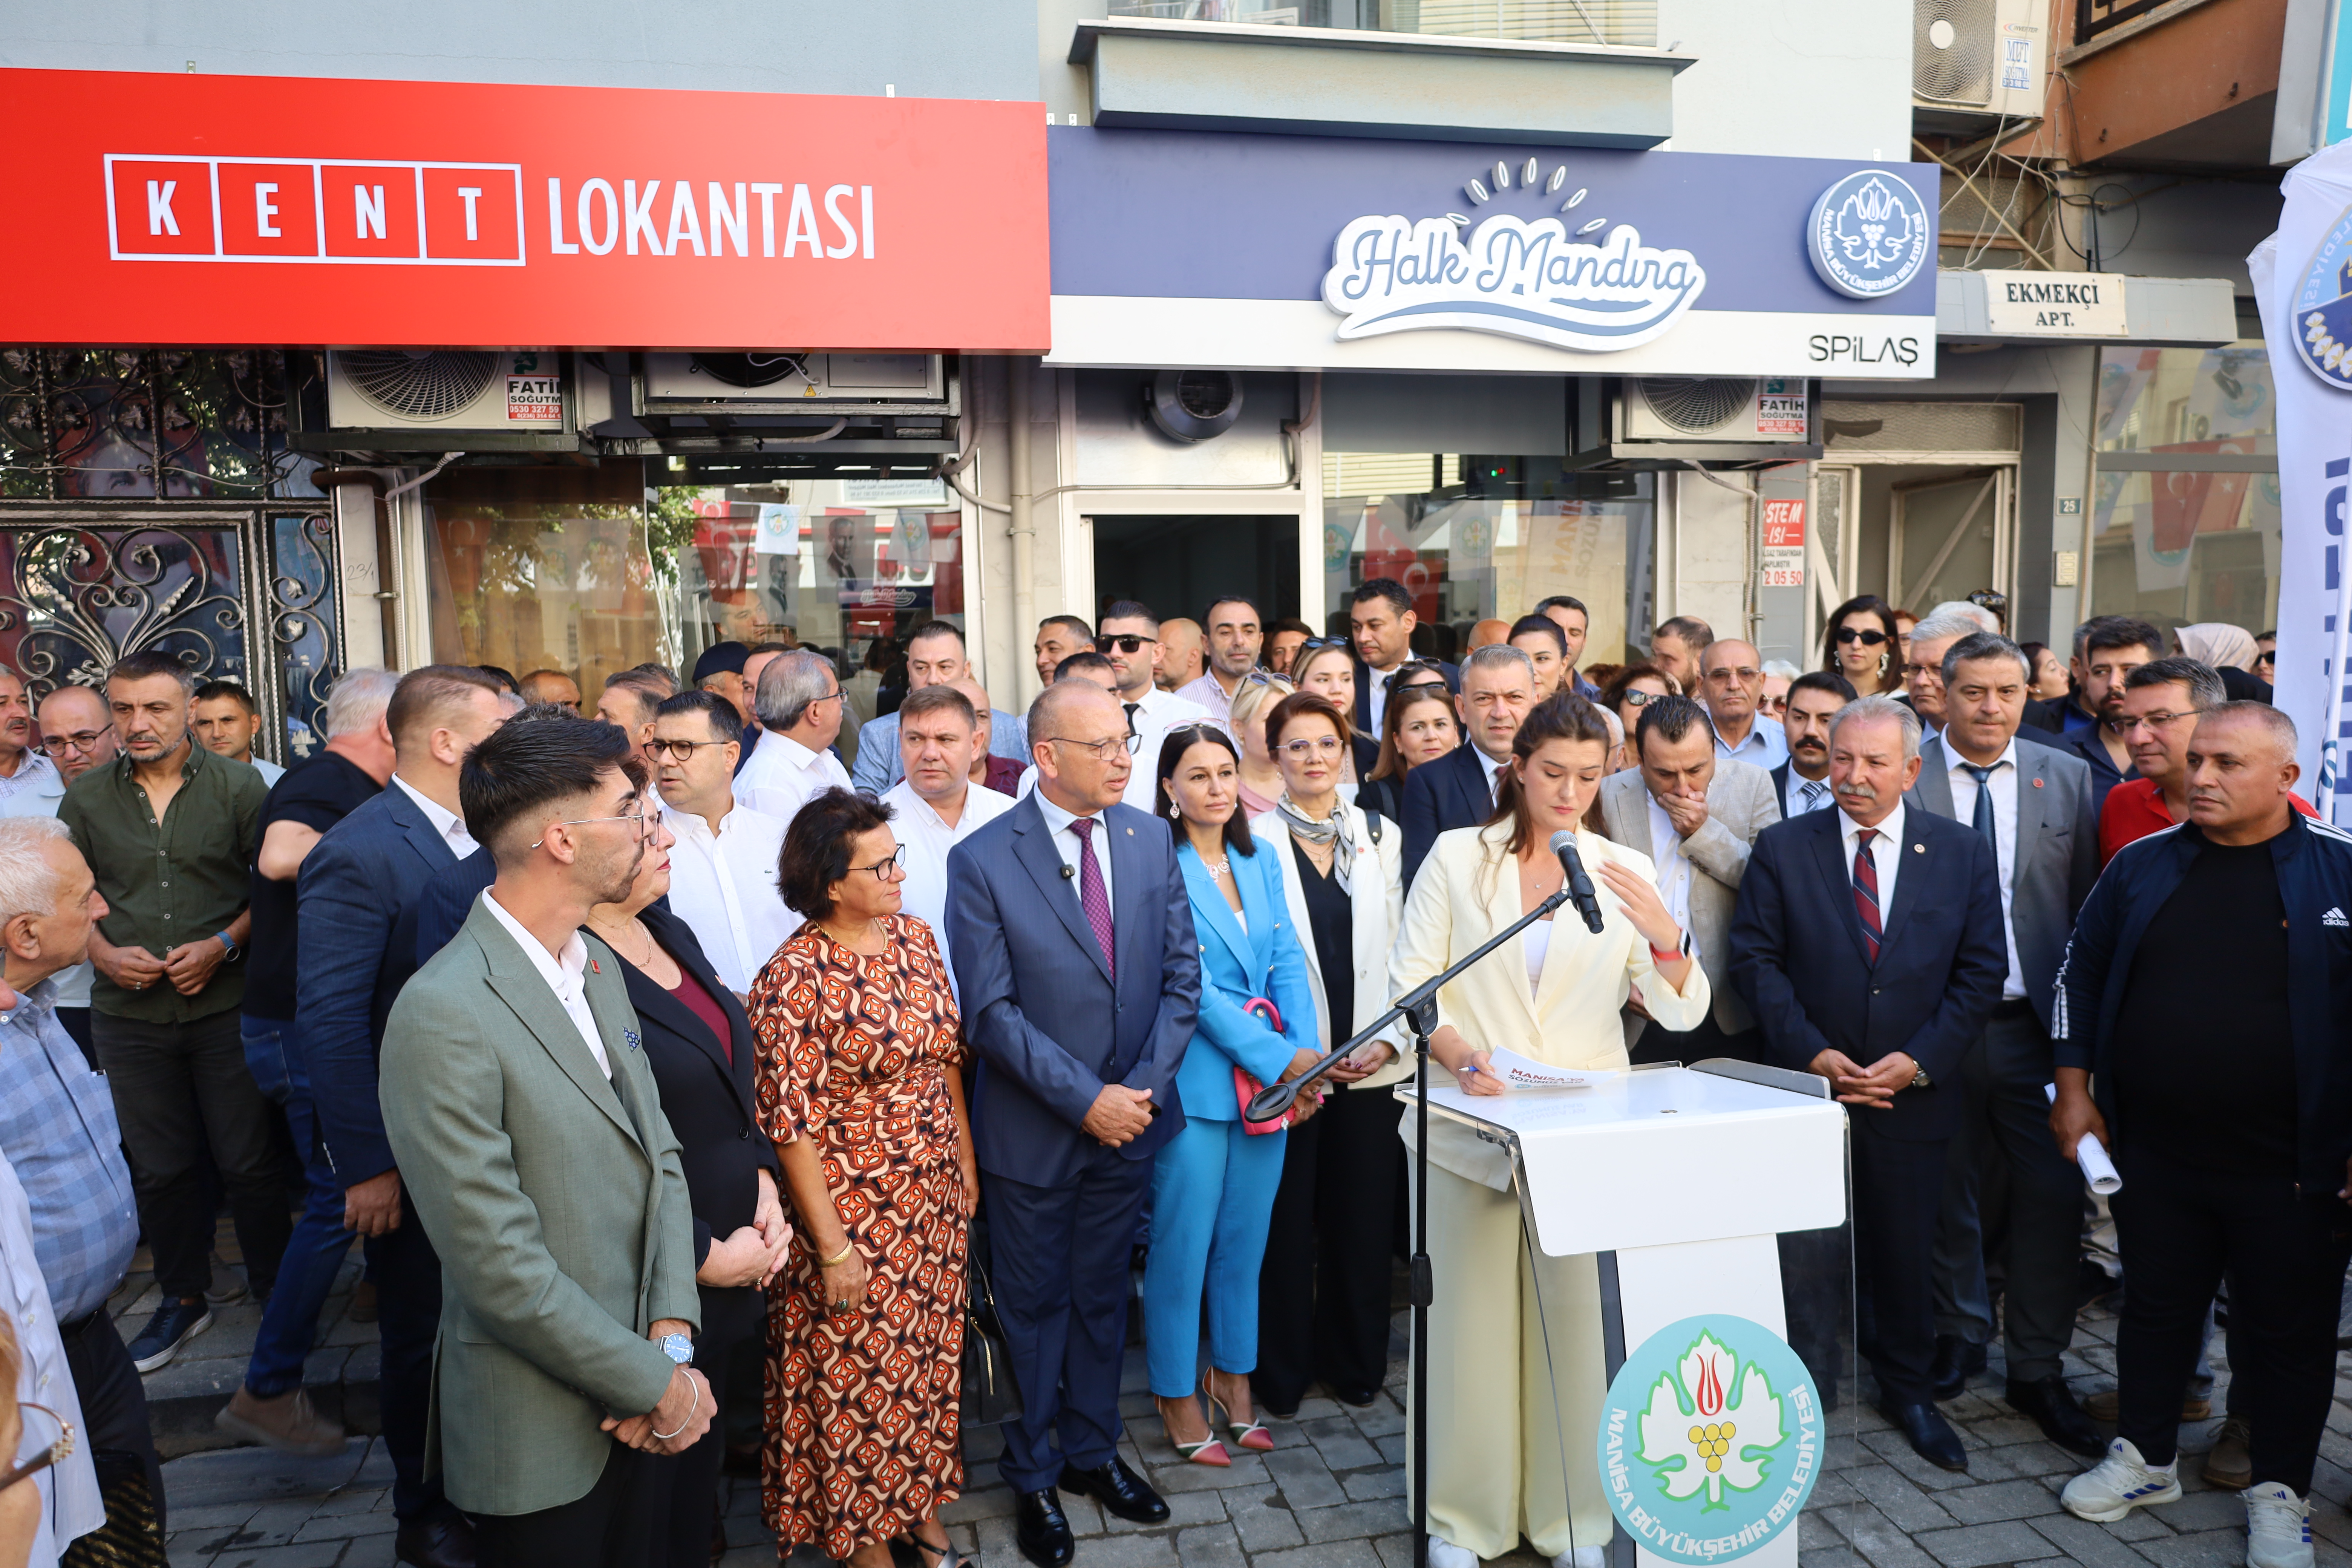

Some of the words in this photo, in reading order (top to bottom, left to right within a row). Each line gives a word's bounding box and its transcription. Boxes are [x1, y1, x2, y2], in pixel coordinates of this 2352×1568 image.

[2006, 40, 2029, 63] MUT
[147, 180, 482, 241] KENT
[548, 177, 875, 259] LOKANTASI
[1822, 208, 1835, 259] MANİSA
[1829, 257, 1899, 292] BÜYÜKŞEHİR
[1895, 212, 1924, 280] BELEDİYESİ
[1342, 229, 1469, 300] Halk
[2006, 278, 2099, 310] EKMEKÇİ
[2035, 312, 2075, 327] APT.
[510, 394, 561, 403] SOĞUTM
[1760, 398, 1804, 410] FATİH
[1763, 502, 1802, 524] STEM
[2063, 500, 2075, 513] 25
[1769, 526, 1786, 544] ISI
[347, 562, 375, 581] 23/1
[1774, 571, 1787, 585] 05
[1790, 571, 1802, 585] 50
[1606, 1407, 1635, 1511] MANİSA
[1627, 1505, 1770, 1561] BÜYÜKŞEHİR
[1766, 1383, 1816, 1525] BELEDİYESİ
